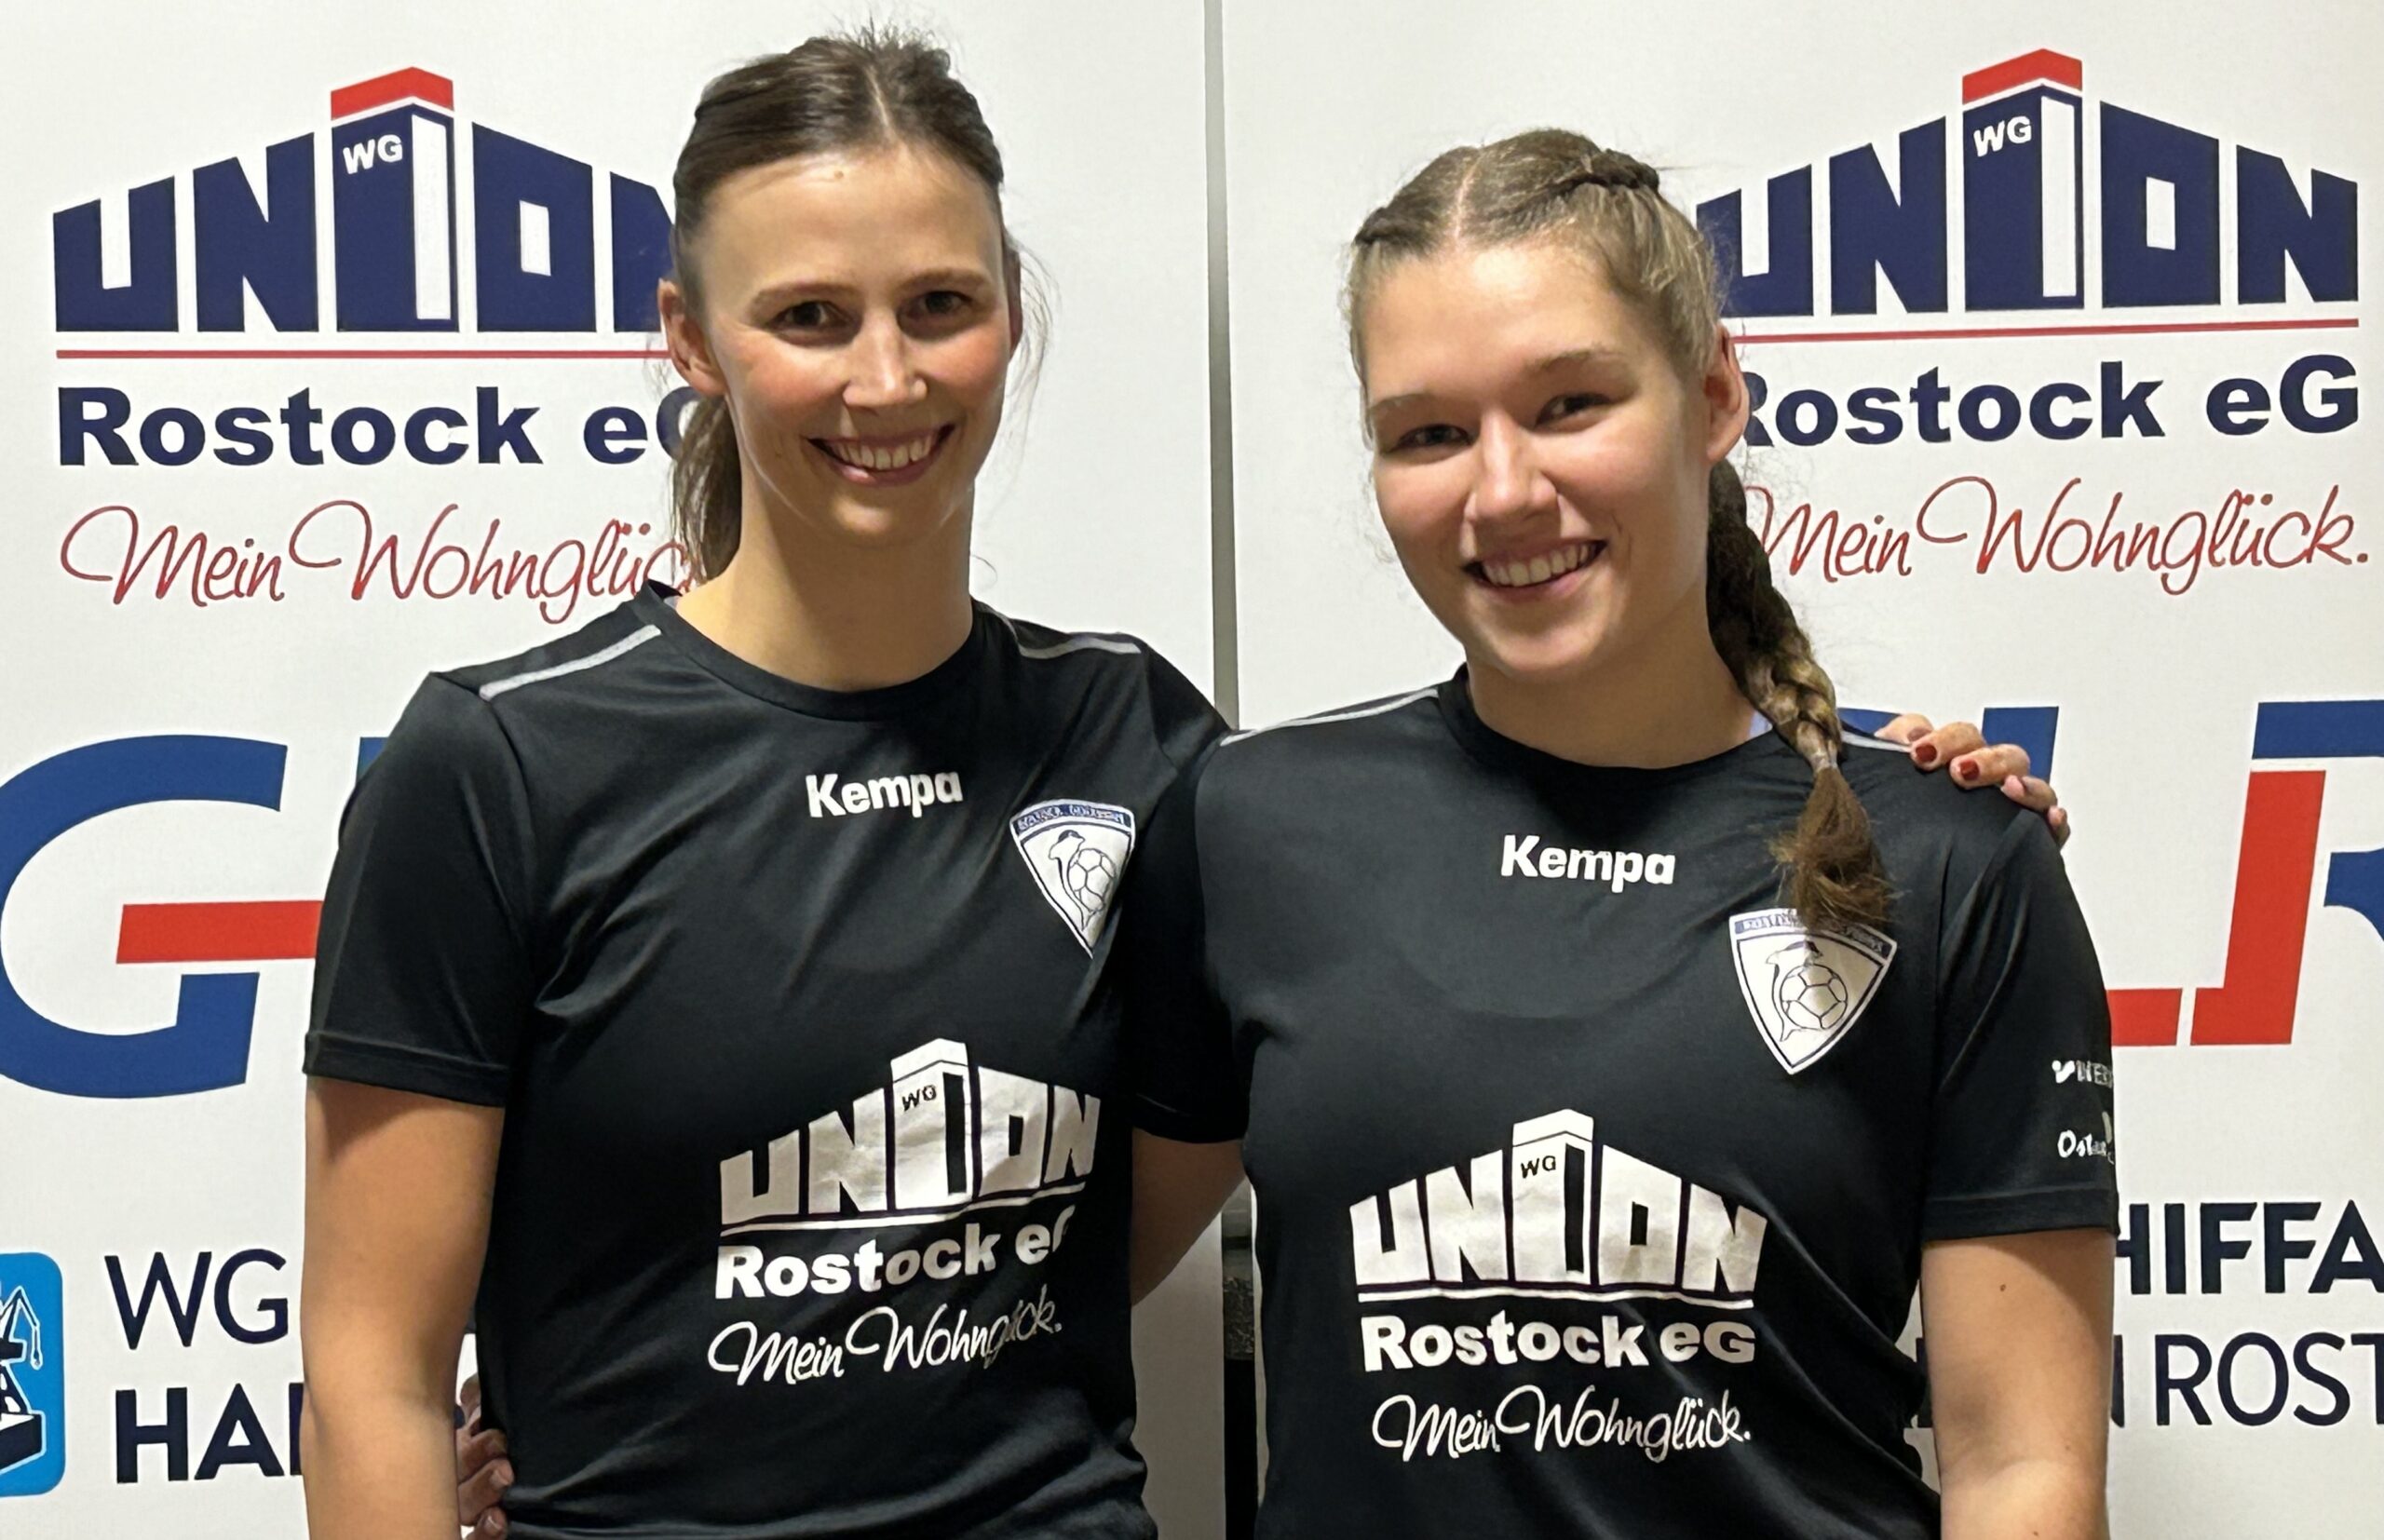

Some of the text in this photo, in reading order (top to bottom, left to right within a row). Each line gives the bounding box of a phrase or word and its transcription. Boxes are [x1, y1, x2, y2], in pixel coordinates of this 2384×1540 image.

[342, 134, 403, 174] WG
[1972, 115, 2033, 156] WG
[1697, 82, 2358, 318] UNION
[58, 385, 544, 466] Rostock
[2205, 354, 2359, 435] eG
[61, 506, 285, 607] Mein
[1745, 476, 2369, 596] Mein Wohnglück.
[806, 771, 964, 819] Kempa
[1500, 834, 1676, 893] Kempa
[720, 1038, 1101, 1225] UNION
[1520, 1155, 1557, 1179] WG
[1349, 1109, 1768, 1292] UNION
[104, 1249, 289, 1350] WG
[714, 1225, 1001, 1301] Rostock
[708, 1320, 845, 1387] Mein
[1361, 1309, 1756, 1373] Rostock eG
[1372, 1384, 1752, 1464] Mein Wohnglück.
